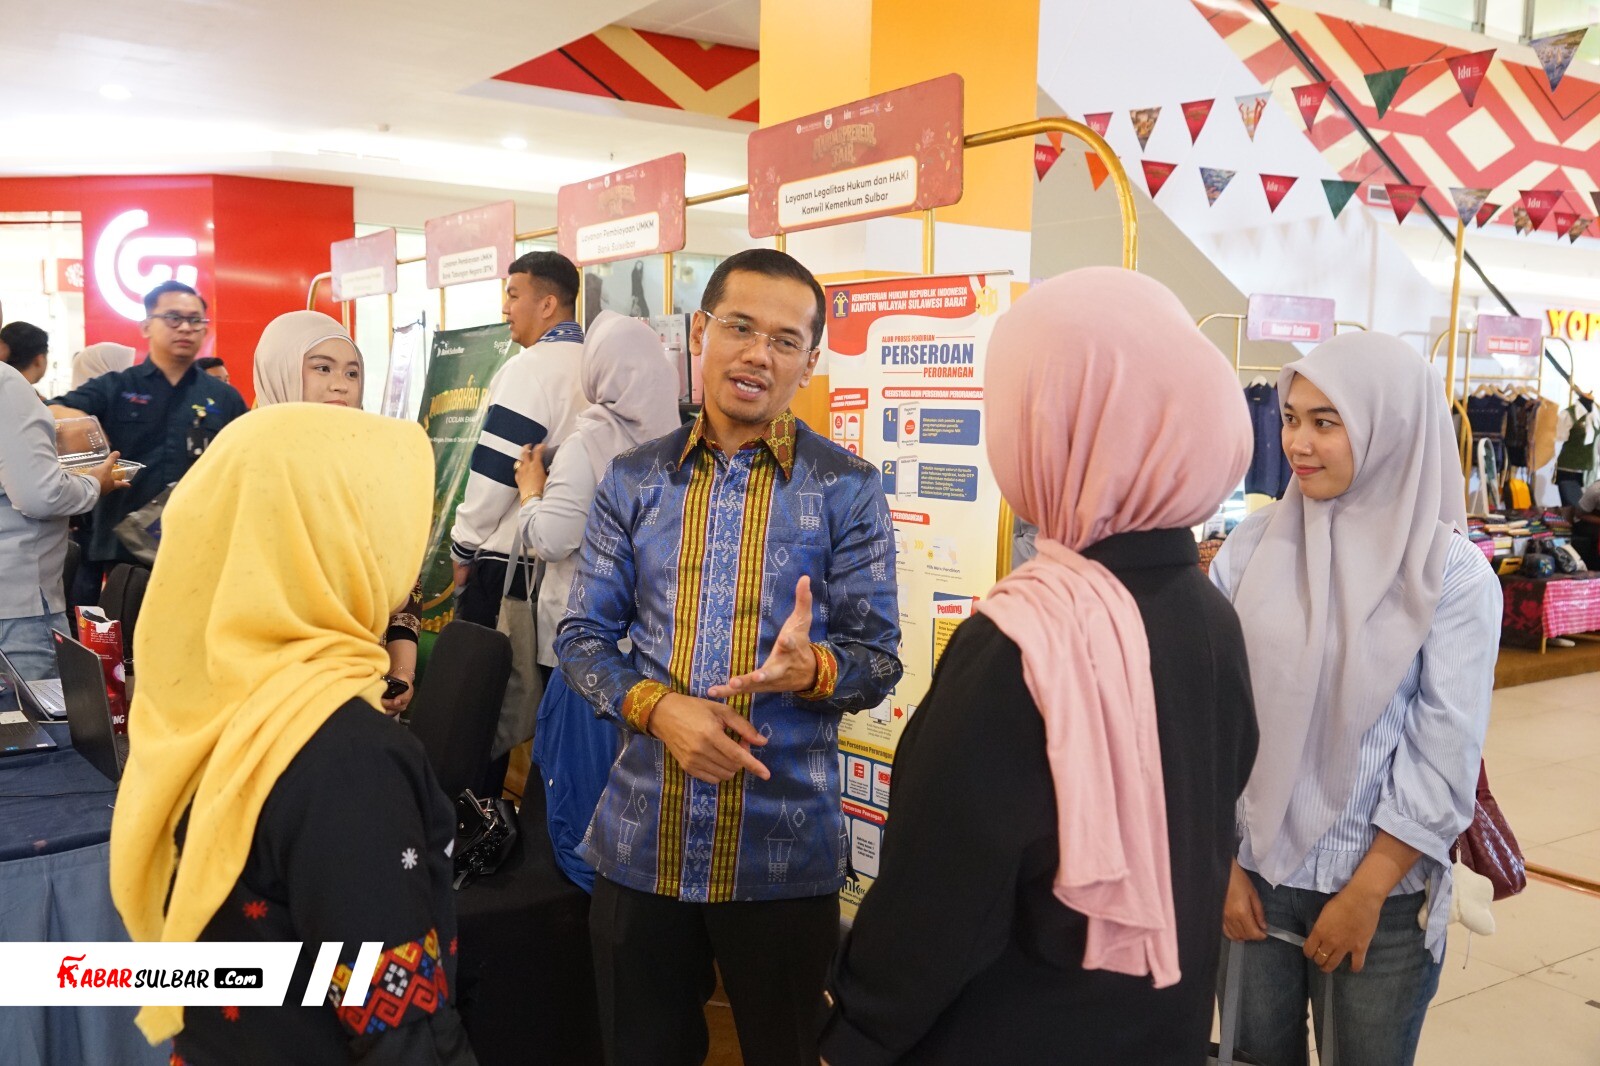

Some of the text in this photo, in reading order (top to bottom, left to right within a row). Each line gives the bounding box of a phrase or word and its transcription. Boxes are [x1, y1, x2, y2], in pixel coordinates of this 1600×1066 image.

[785, 169, 909, 204] Layanan Legalitas Hukum dan HAKI
[802, 191, 889, 216] Kanwil Kemenkum Sulbar
[636, 219, 655, 231] UMKM
[851, 286, 968, 303] KEMENTERIAN HUKUM REPUBLIK INDONESIA
[851, 296, 968, 313] KANTOR WILAYAH SULAWESI BARAT
[894, 335, 911, 343] PROSES
[881, 343, 975, 365] PERSEROAN
[923, 367, 974, 378] PERORANGAN
[885, 390, 911, 398] REGISTRASI
[921, 390, 949, 398] PERSEROAN
[950, 391, 984, 399] PERORANGAN
[886, 410, 896, 422] 1.
[884, 462, 895, 475] 2.
[893, 512, 924, 523] PERORANGAN
[937, 604, 962, 614] Penting
[847, 741, 869, 753] Perseroan
[869, 746, 893, 759] Perorangan
